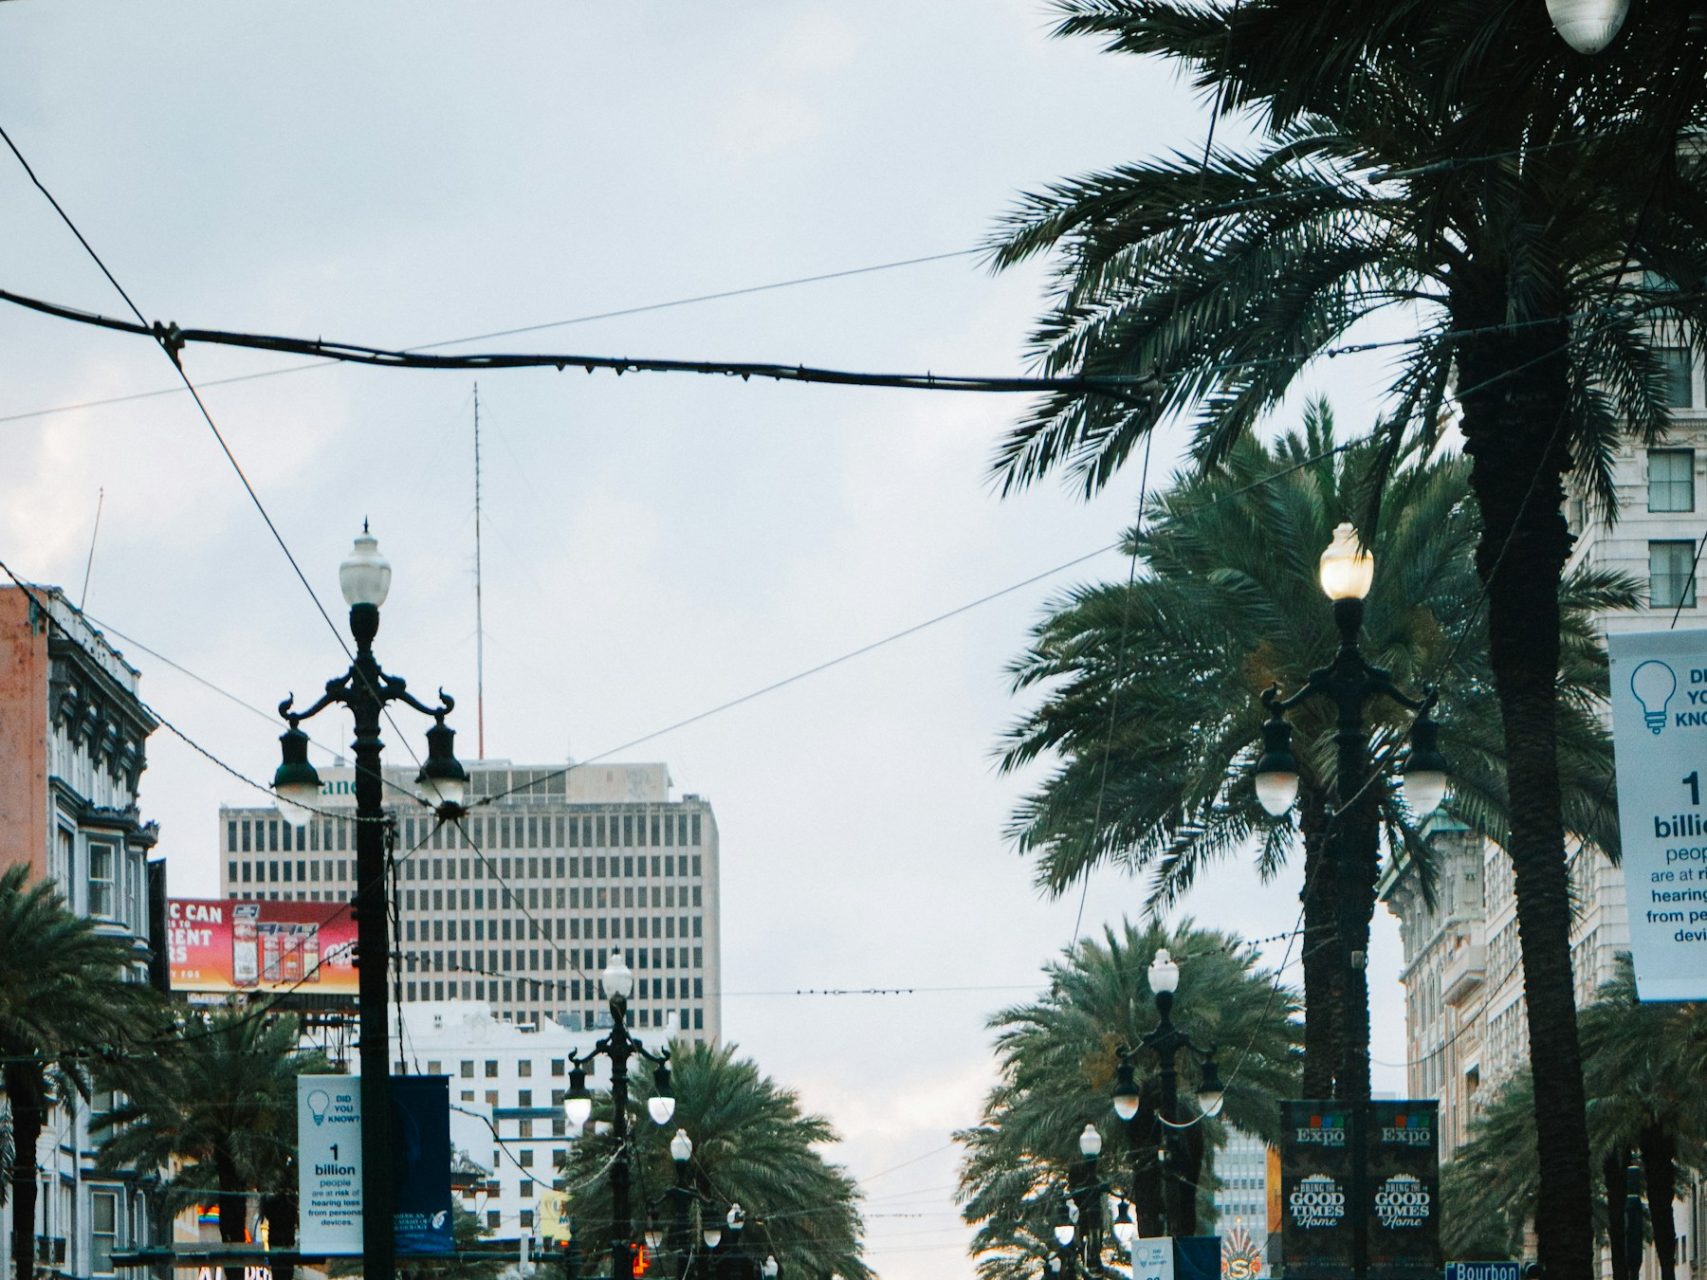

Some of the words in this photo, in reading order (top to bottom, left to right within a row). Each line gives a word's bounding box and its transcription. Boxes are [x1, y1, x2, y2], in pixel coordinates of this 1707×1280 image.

[1682, 771, 1700, 806] 1
[1651, 871, 1674, 882] are
[1680, 868, 1693, 881] at
[186, 904, 222, 923] CAN
[1647, 910, 1684, 923] from
[1296, 1128, 1345, 1146] Expo
[1381, 1128, 1431, 1146] Expo
[329, 1143, 338, 1161] 1
[315, 1164, 355, 1175] billion
[320, 1179, 351, 1188] people
[1300, 1183, 1324, 1193] BRING
[1385, 1183, 1409, 1193] BRING
[1290, 1192, 1345, 1206] GOOD
[1375, 1192, 1430, 1206] GOOD
[1290, 1205, 1345, 1217] TIMES
[1375, 1205, 1430, 1217] TIMES
[1297, 1215, 1338, 1229] Home
[1382, 1215, 1423, 1229] Home
[1457, 1263, 1516, 1280] Bourbon
